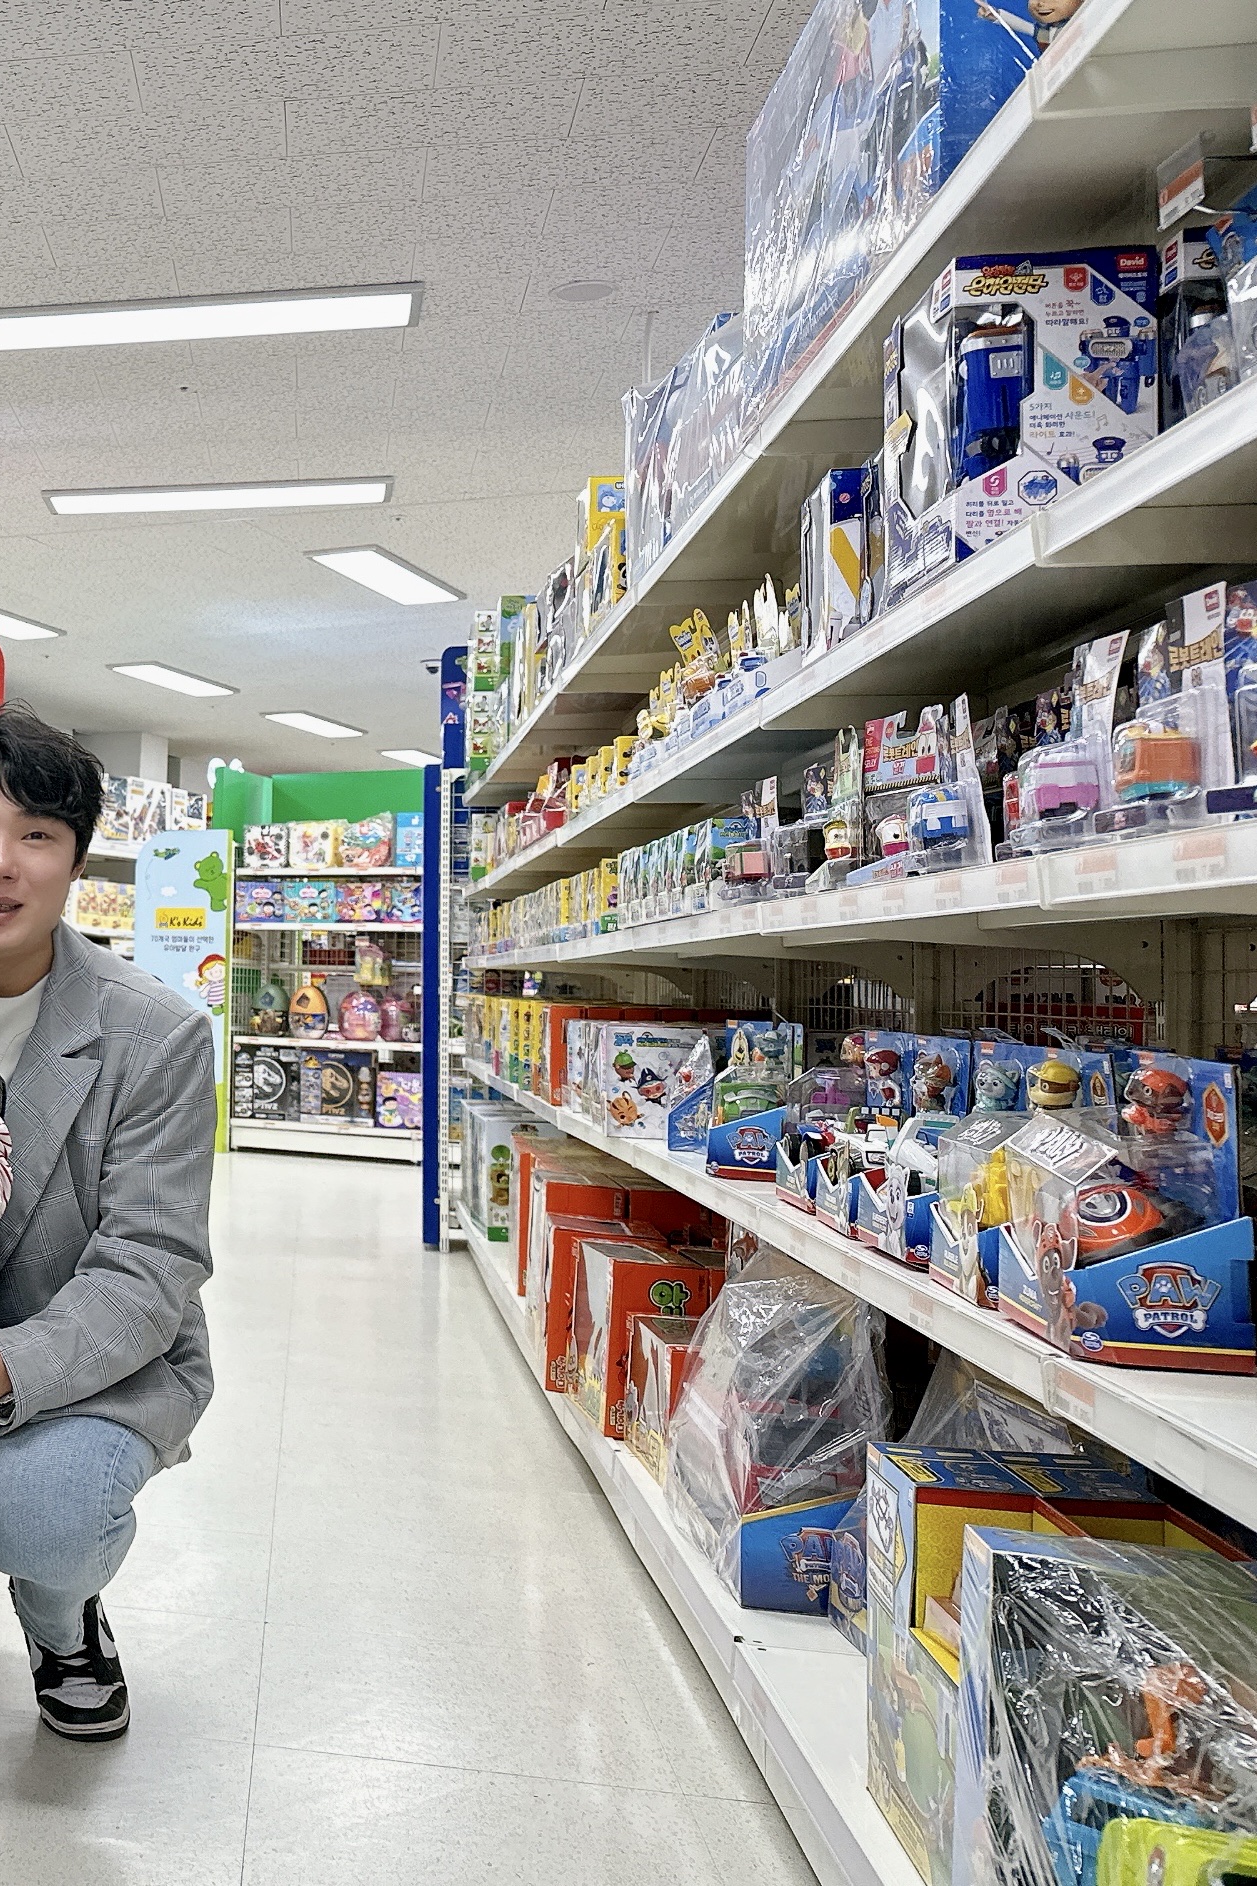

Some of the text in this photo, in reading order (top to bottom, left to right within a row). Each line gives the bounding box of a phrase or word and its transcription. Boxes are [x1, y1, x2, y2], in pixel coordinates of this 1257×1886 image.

[1120, 257, 1145, 266] David
[183, 916, 202, 927] Kids
[727, 1128, 778, 1150] PAW
[738, 1151, 766, 1159] PATROL
[1117, 1272, 1223, 1312] PAW
[1143, 1309, 1199, 1325] PATROL
[792, 1572, 810, 1584] THE
